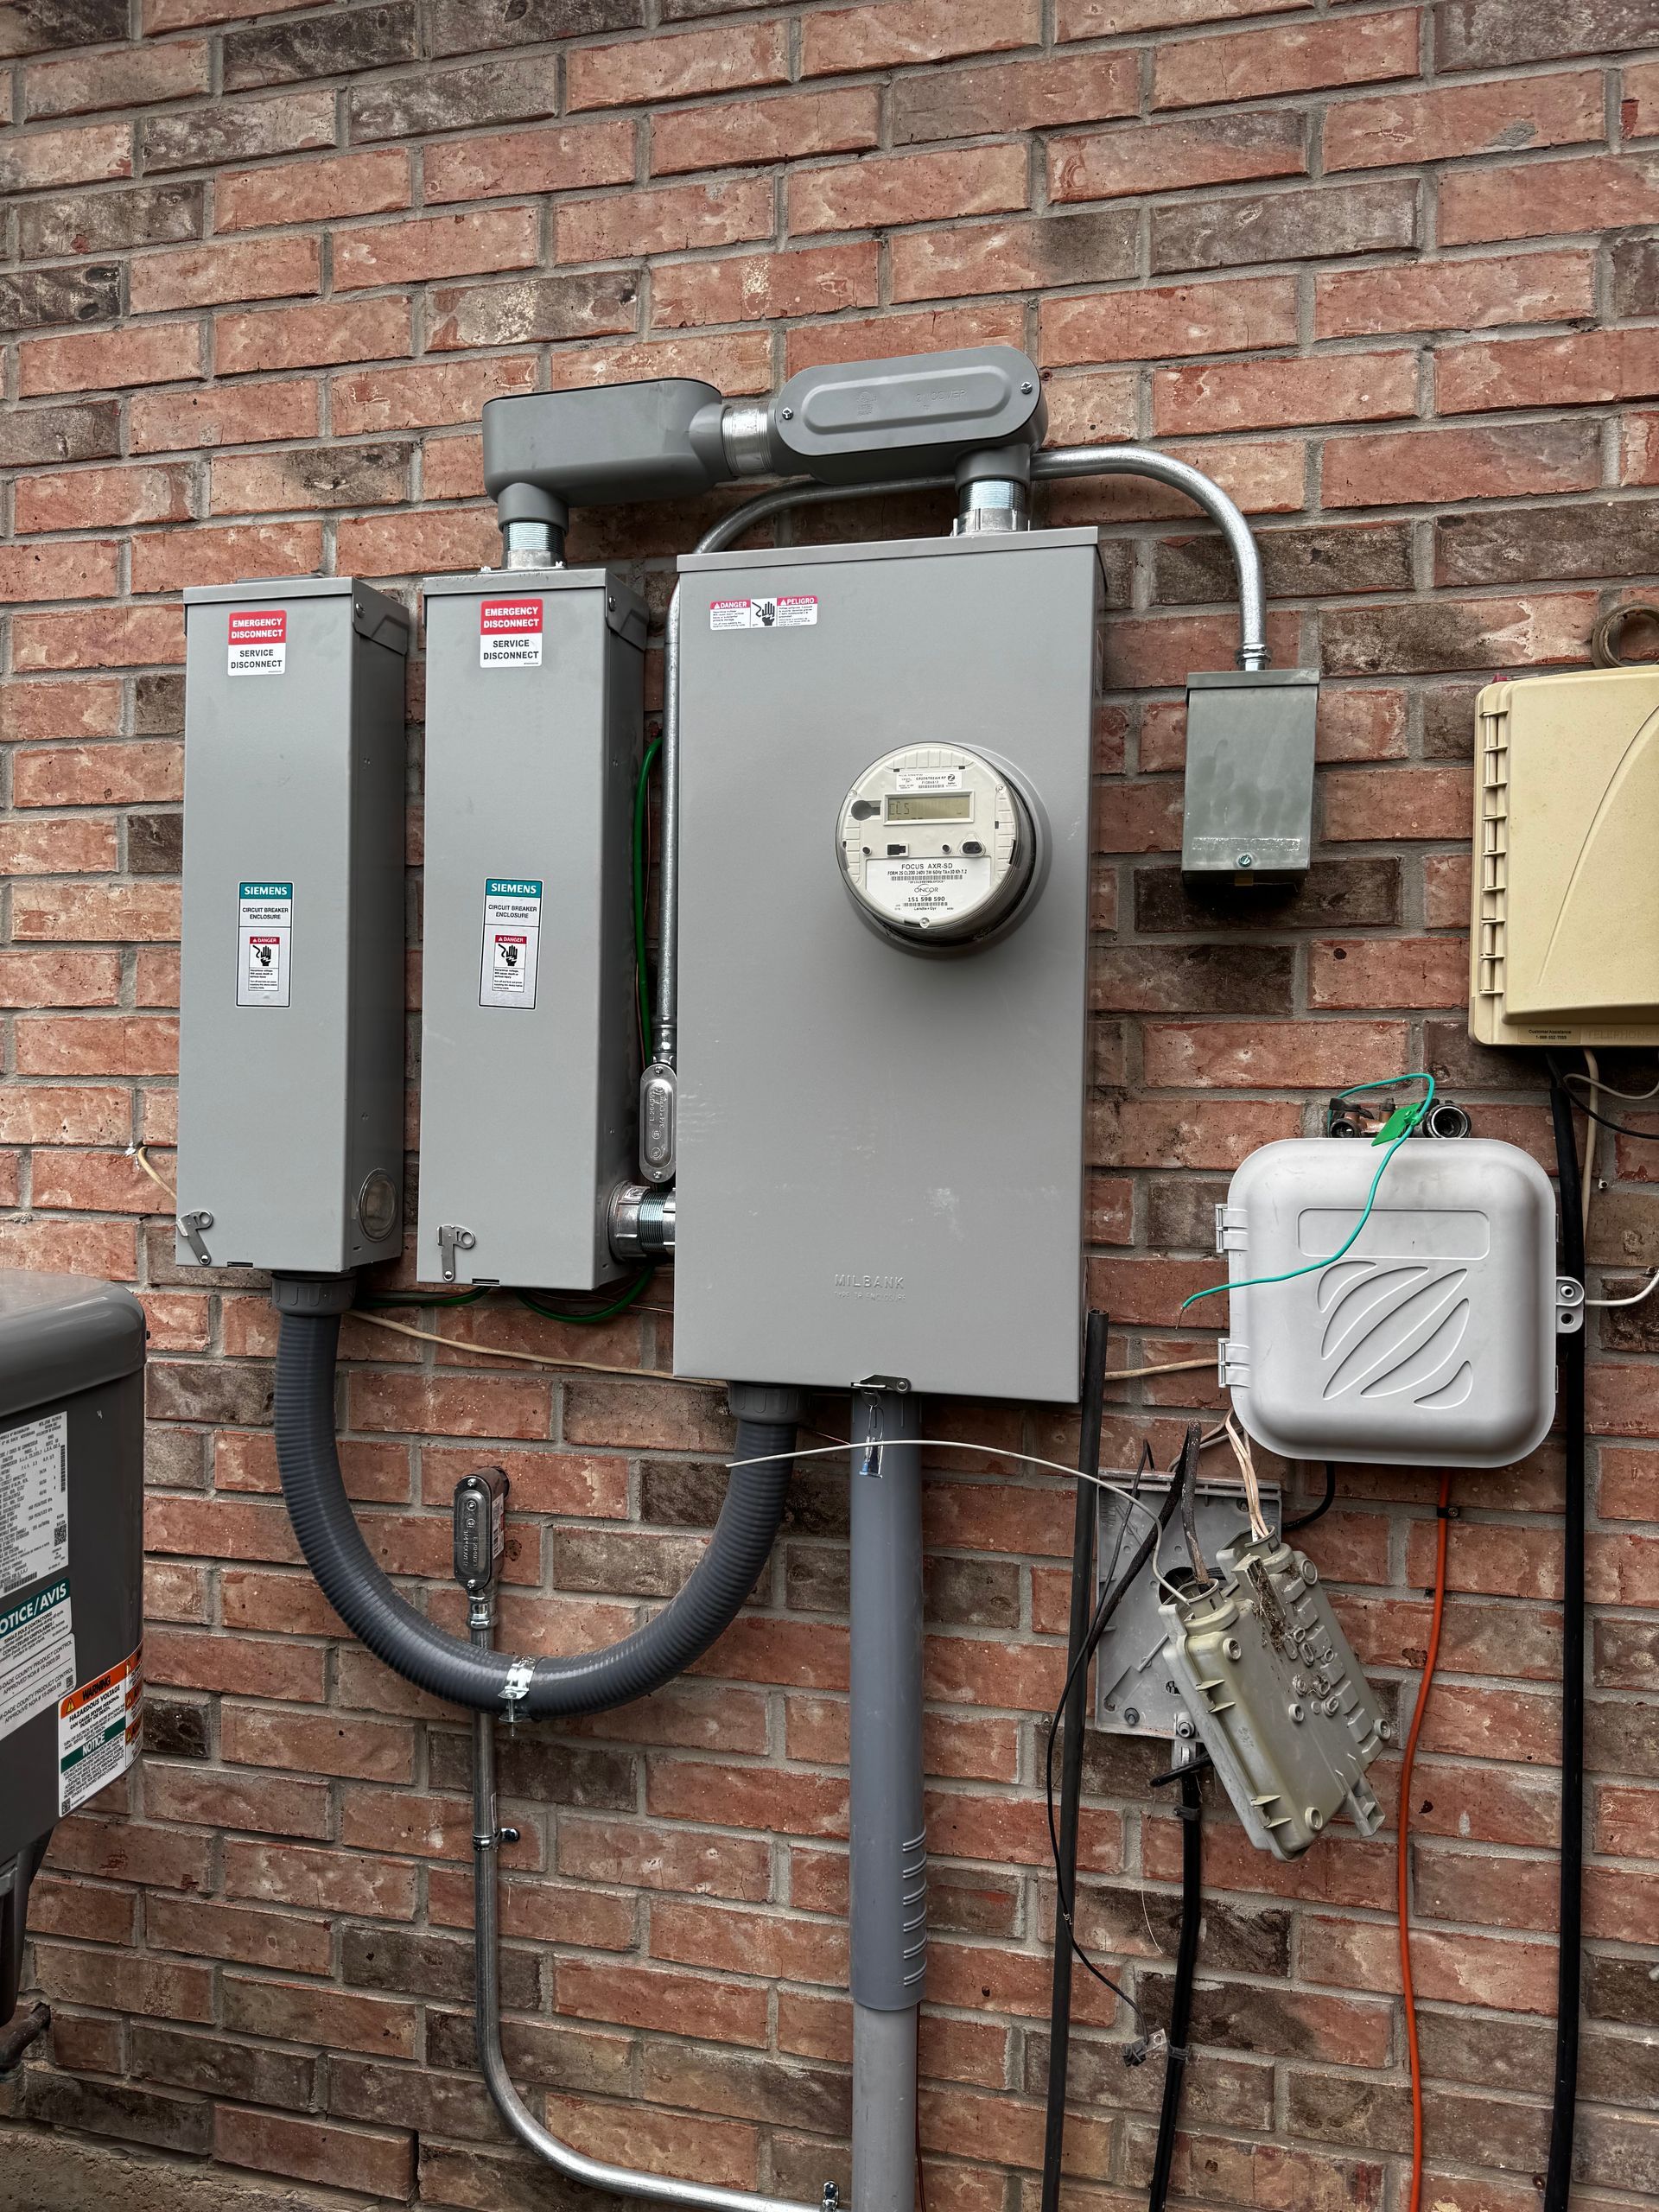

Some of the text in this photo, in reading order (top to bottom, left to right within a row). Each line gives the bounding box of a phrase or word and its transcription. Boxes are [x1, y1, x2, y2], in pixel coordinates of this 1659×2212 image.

[485, 606, 539, 617] EMERGENCY
[232, 618, 283, 628] EMERGENCY
[483, 617, 539, 628] DISCONNECT
[231, 628, 283, 639] DISCONNECT
[493, 639, 530, 648] SERVICE
[483, 650, 539, 660] DISCONNECT
[231, 659, 283, 669] DISCONNECT
[244, 886, 288, 895] SIEMENS
[491, 882, 537, 893] SIEMENS
[835, 1274, 905, 1289] MILBANK
[15, 1665, 32, 1680] COUNTY
[33, 1651, 53, 1668] PRODUCT
[54, 1639, 72, 1655] CONTROL
[16, 1693, 34, 1708] COUNTY
[35, 1680, 54, 1695] PRODUCT
[55, 1667, 73, 1682] CONTROL
[82, 1675, 111, 1701] WARNING
[69, 1685, 119, 1721] HAZARDOUS VOLTAGE
[79, 1713, 89, 1724] CAUSE
[90, 1706, 102, 1716] SEVERE
[103, 1694, 119, 1707] PERSONAL
[79, 1717, 92, 1728] INJURY
[82, 1732, 105, 1757] NOTICE
